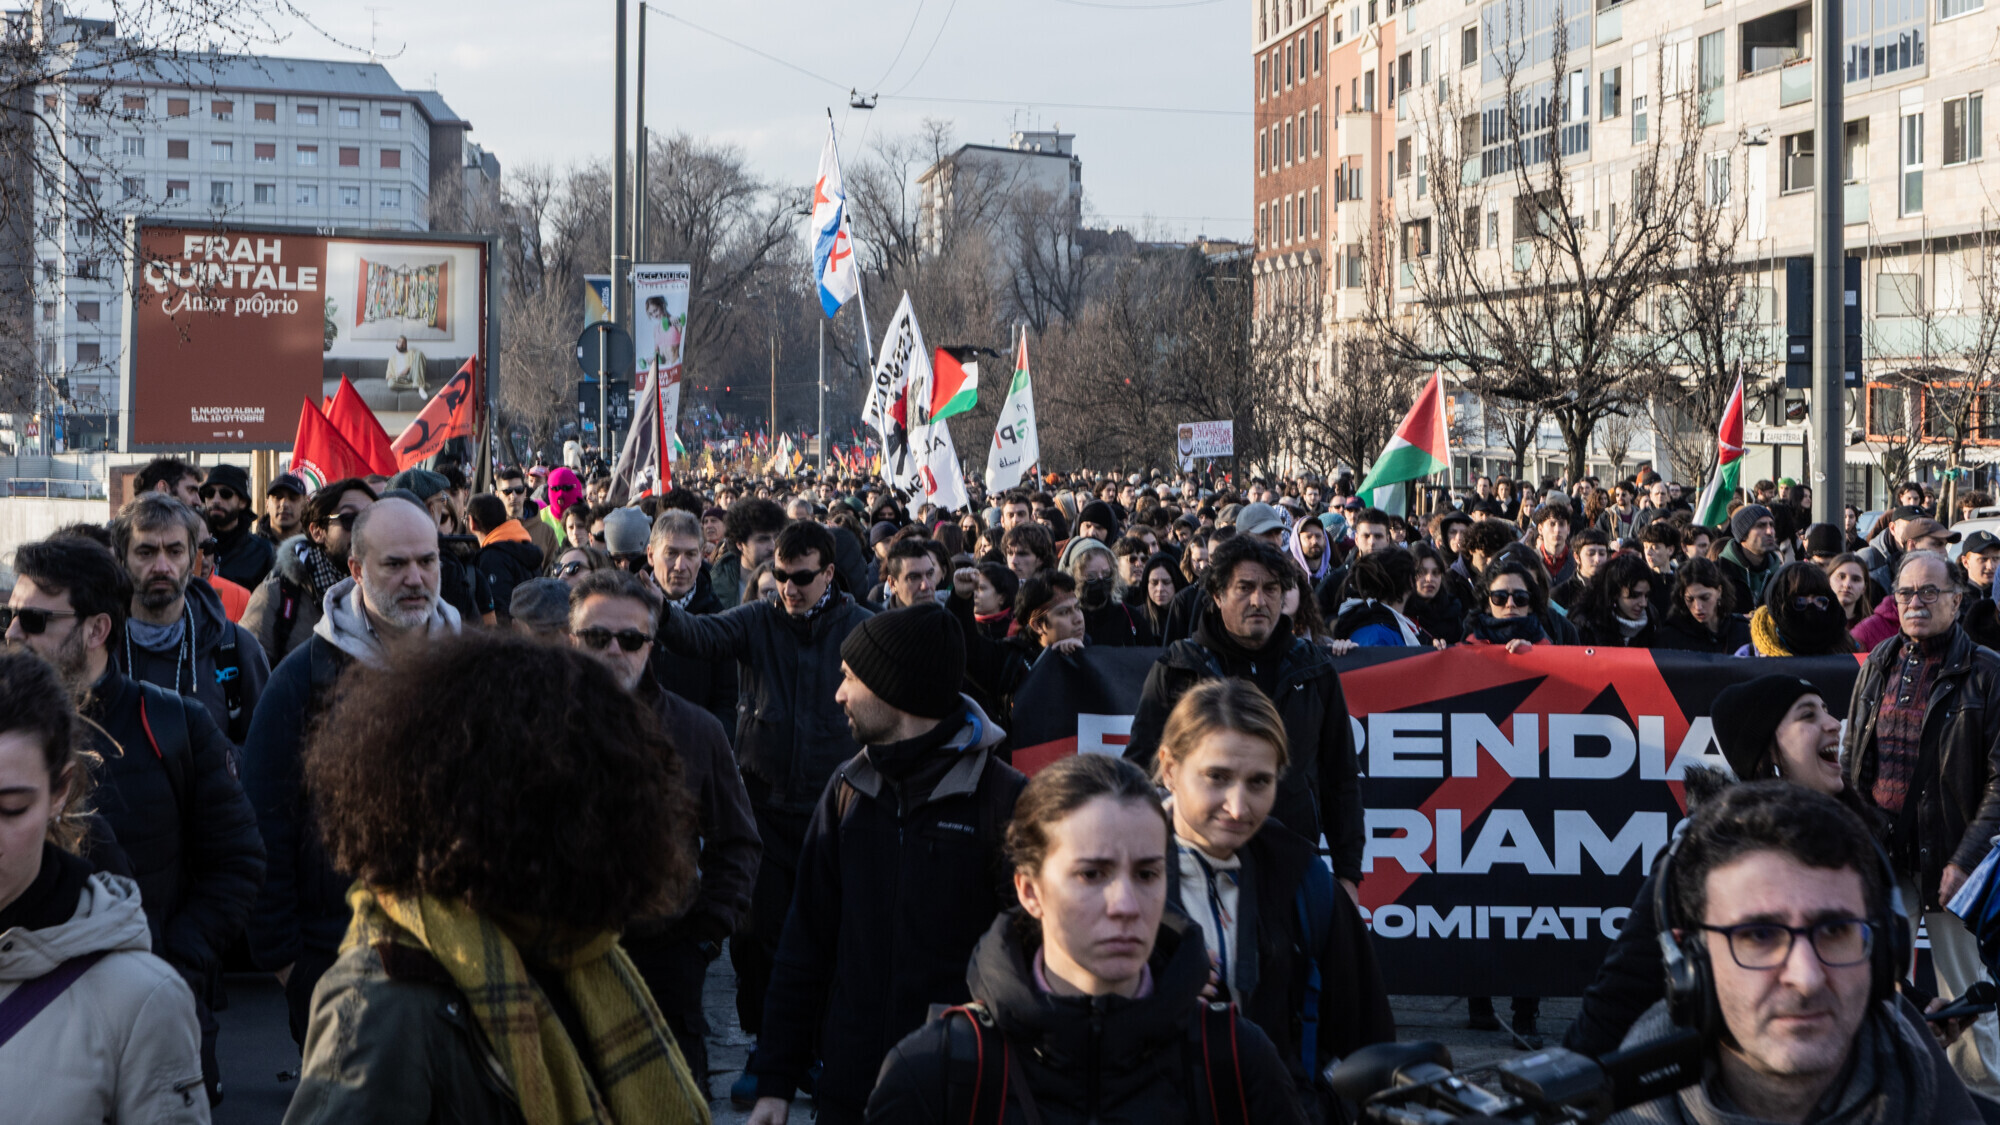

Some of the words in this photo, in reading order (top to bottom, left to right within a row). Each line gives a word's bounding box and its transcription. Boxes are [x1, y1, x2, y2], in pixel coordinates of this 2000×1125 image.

[184, 235, 281, 264] FRAH
[144, 260, 318, 292] QUINTALE
[191, 406, 199, 415] IL
[200, 406, 232, 415] NUOVO
[233, 406, 265, 415] ALBUM
[191, 414, 209, 423] DAL
[210, 414, 222, 423] 10
[222, 414, 265, 423] OTTOBRE
